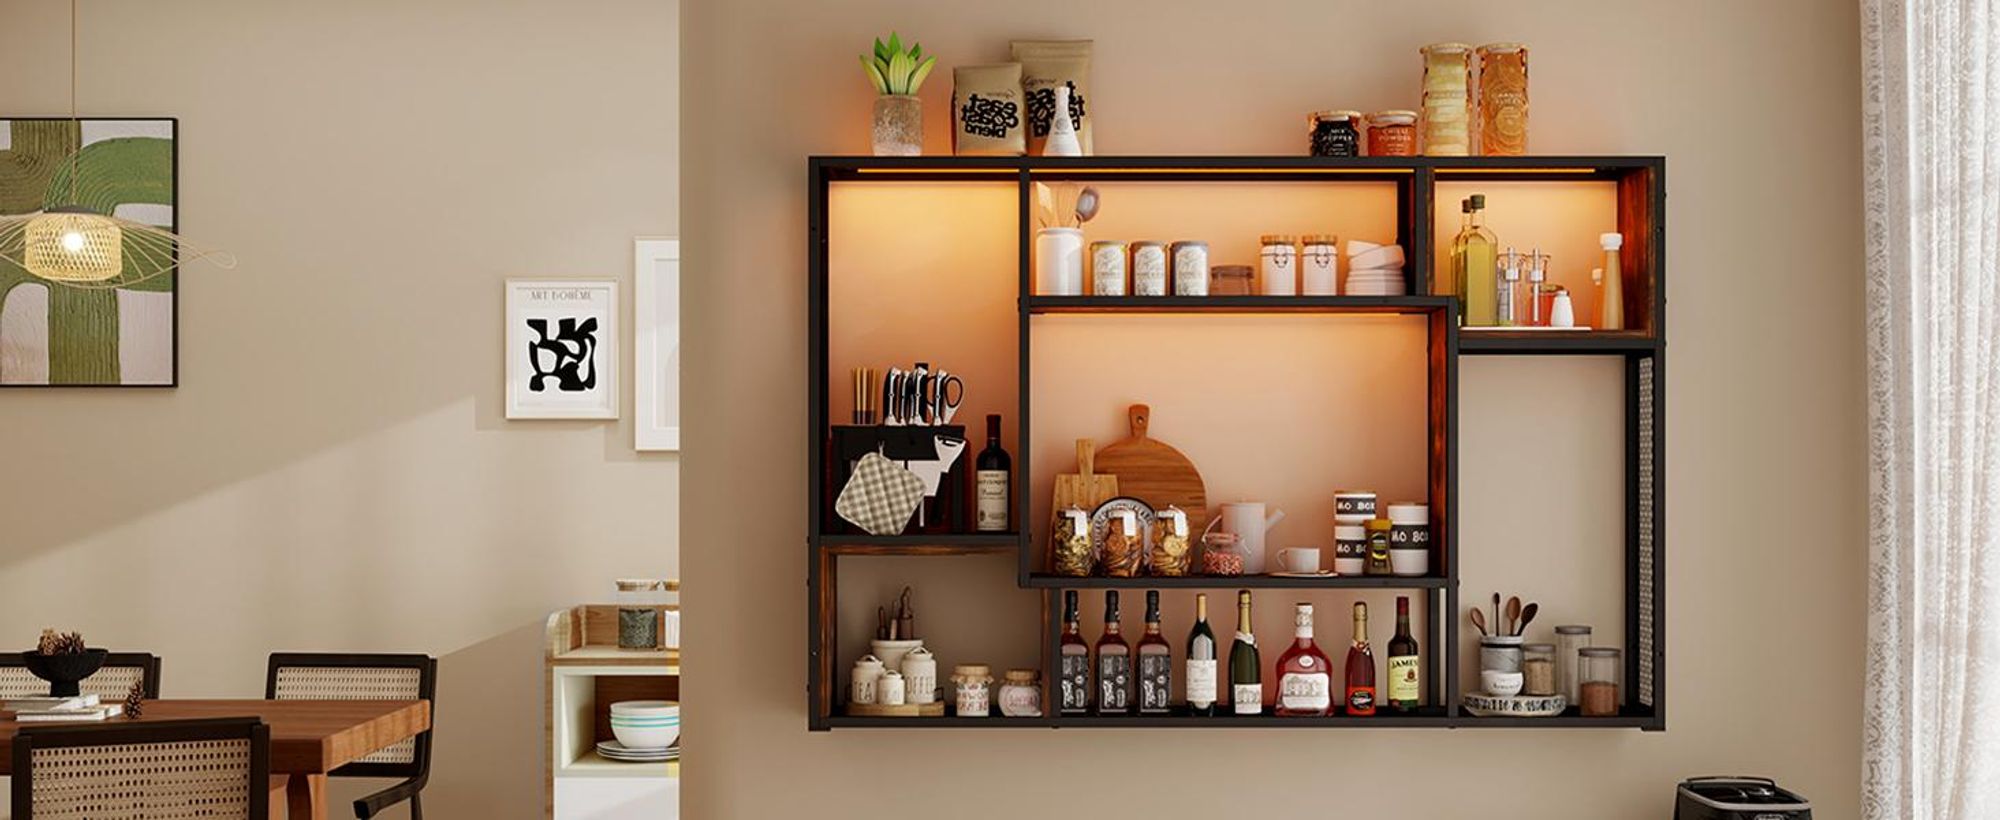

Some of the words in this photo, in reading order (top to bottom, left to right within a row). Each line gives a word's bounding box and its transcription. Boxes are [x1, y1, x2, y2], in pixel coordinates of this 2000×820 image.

[1026, 81, 1076, 108] eat
[531, 290, 548, 300] ART
[854, 681, 873, 701] TEA
